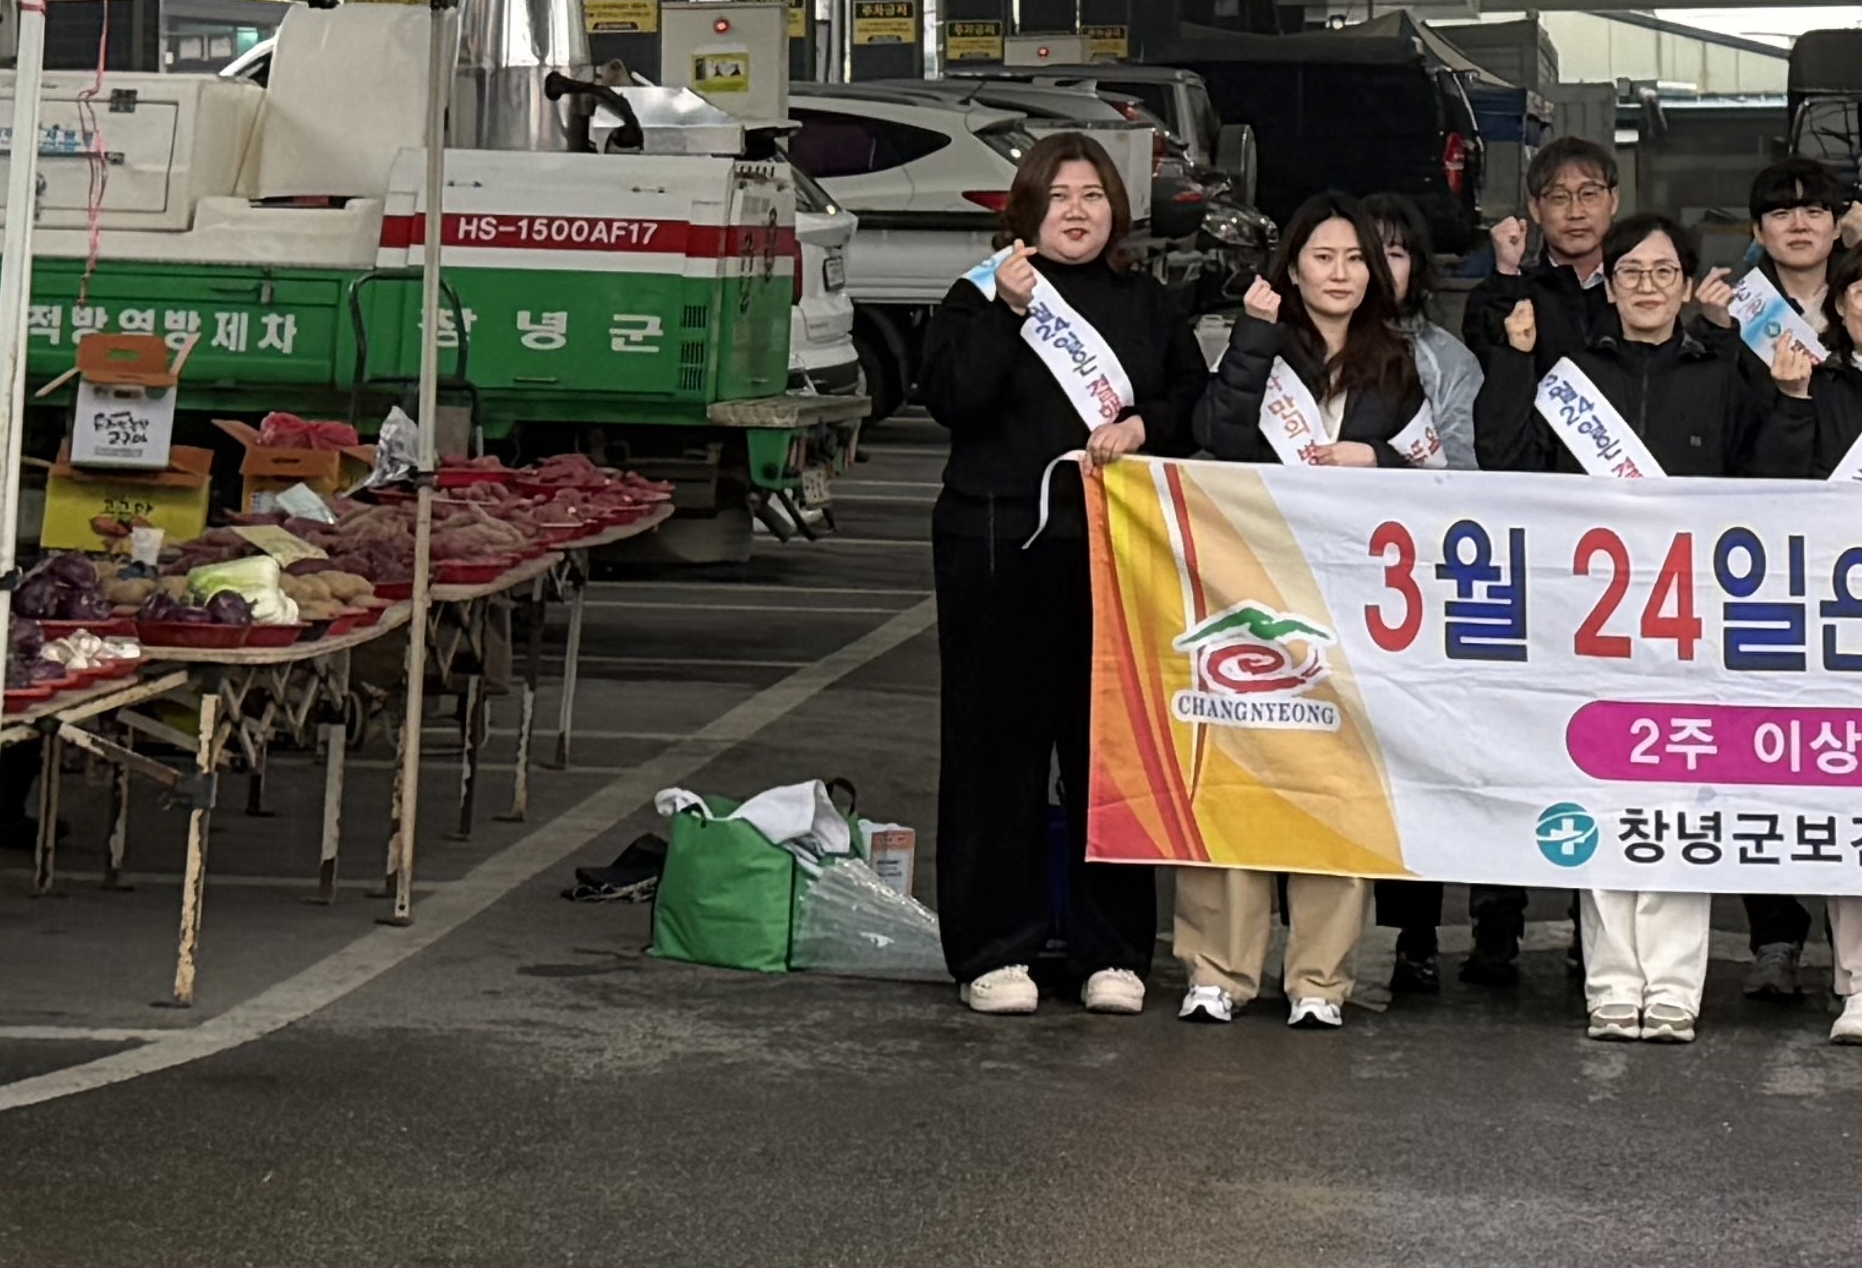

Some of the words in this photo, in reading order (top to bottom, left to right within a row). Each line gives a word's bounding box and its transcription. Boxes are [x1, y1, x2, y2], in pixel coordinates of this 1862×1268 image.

[458, 216, 658, 245] HS-1500AF17
[1364, 519, 1529, 663] 3월
[1177, 695, 1335, 726] CHANGNYEONG
[1628, 717, 1718, 771] 2주
[1753, 719, 1862, 776] 이상
